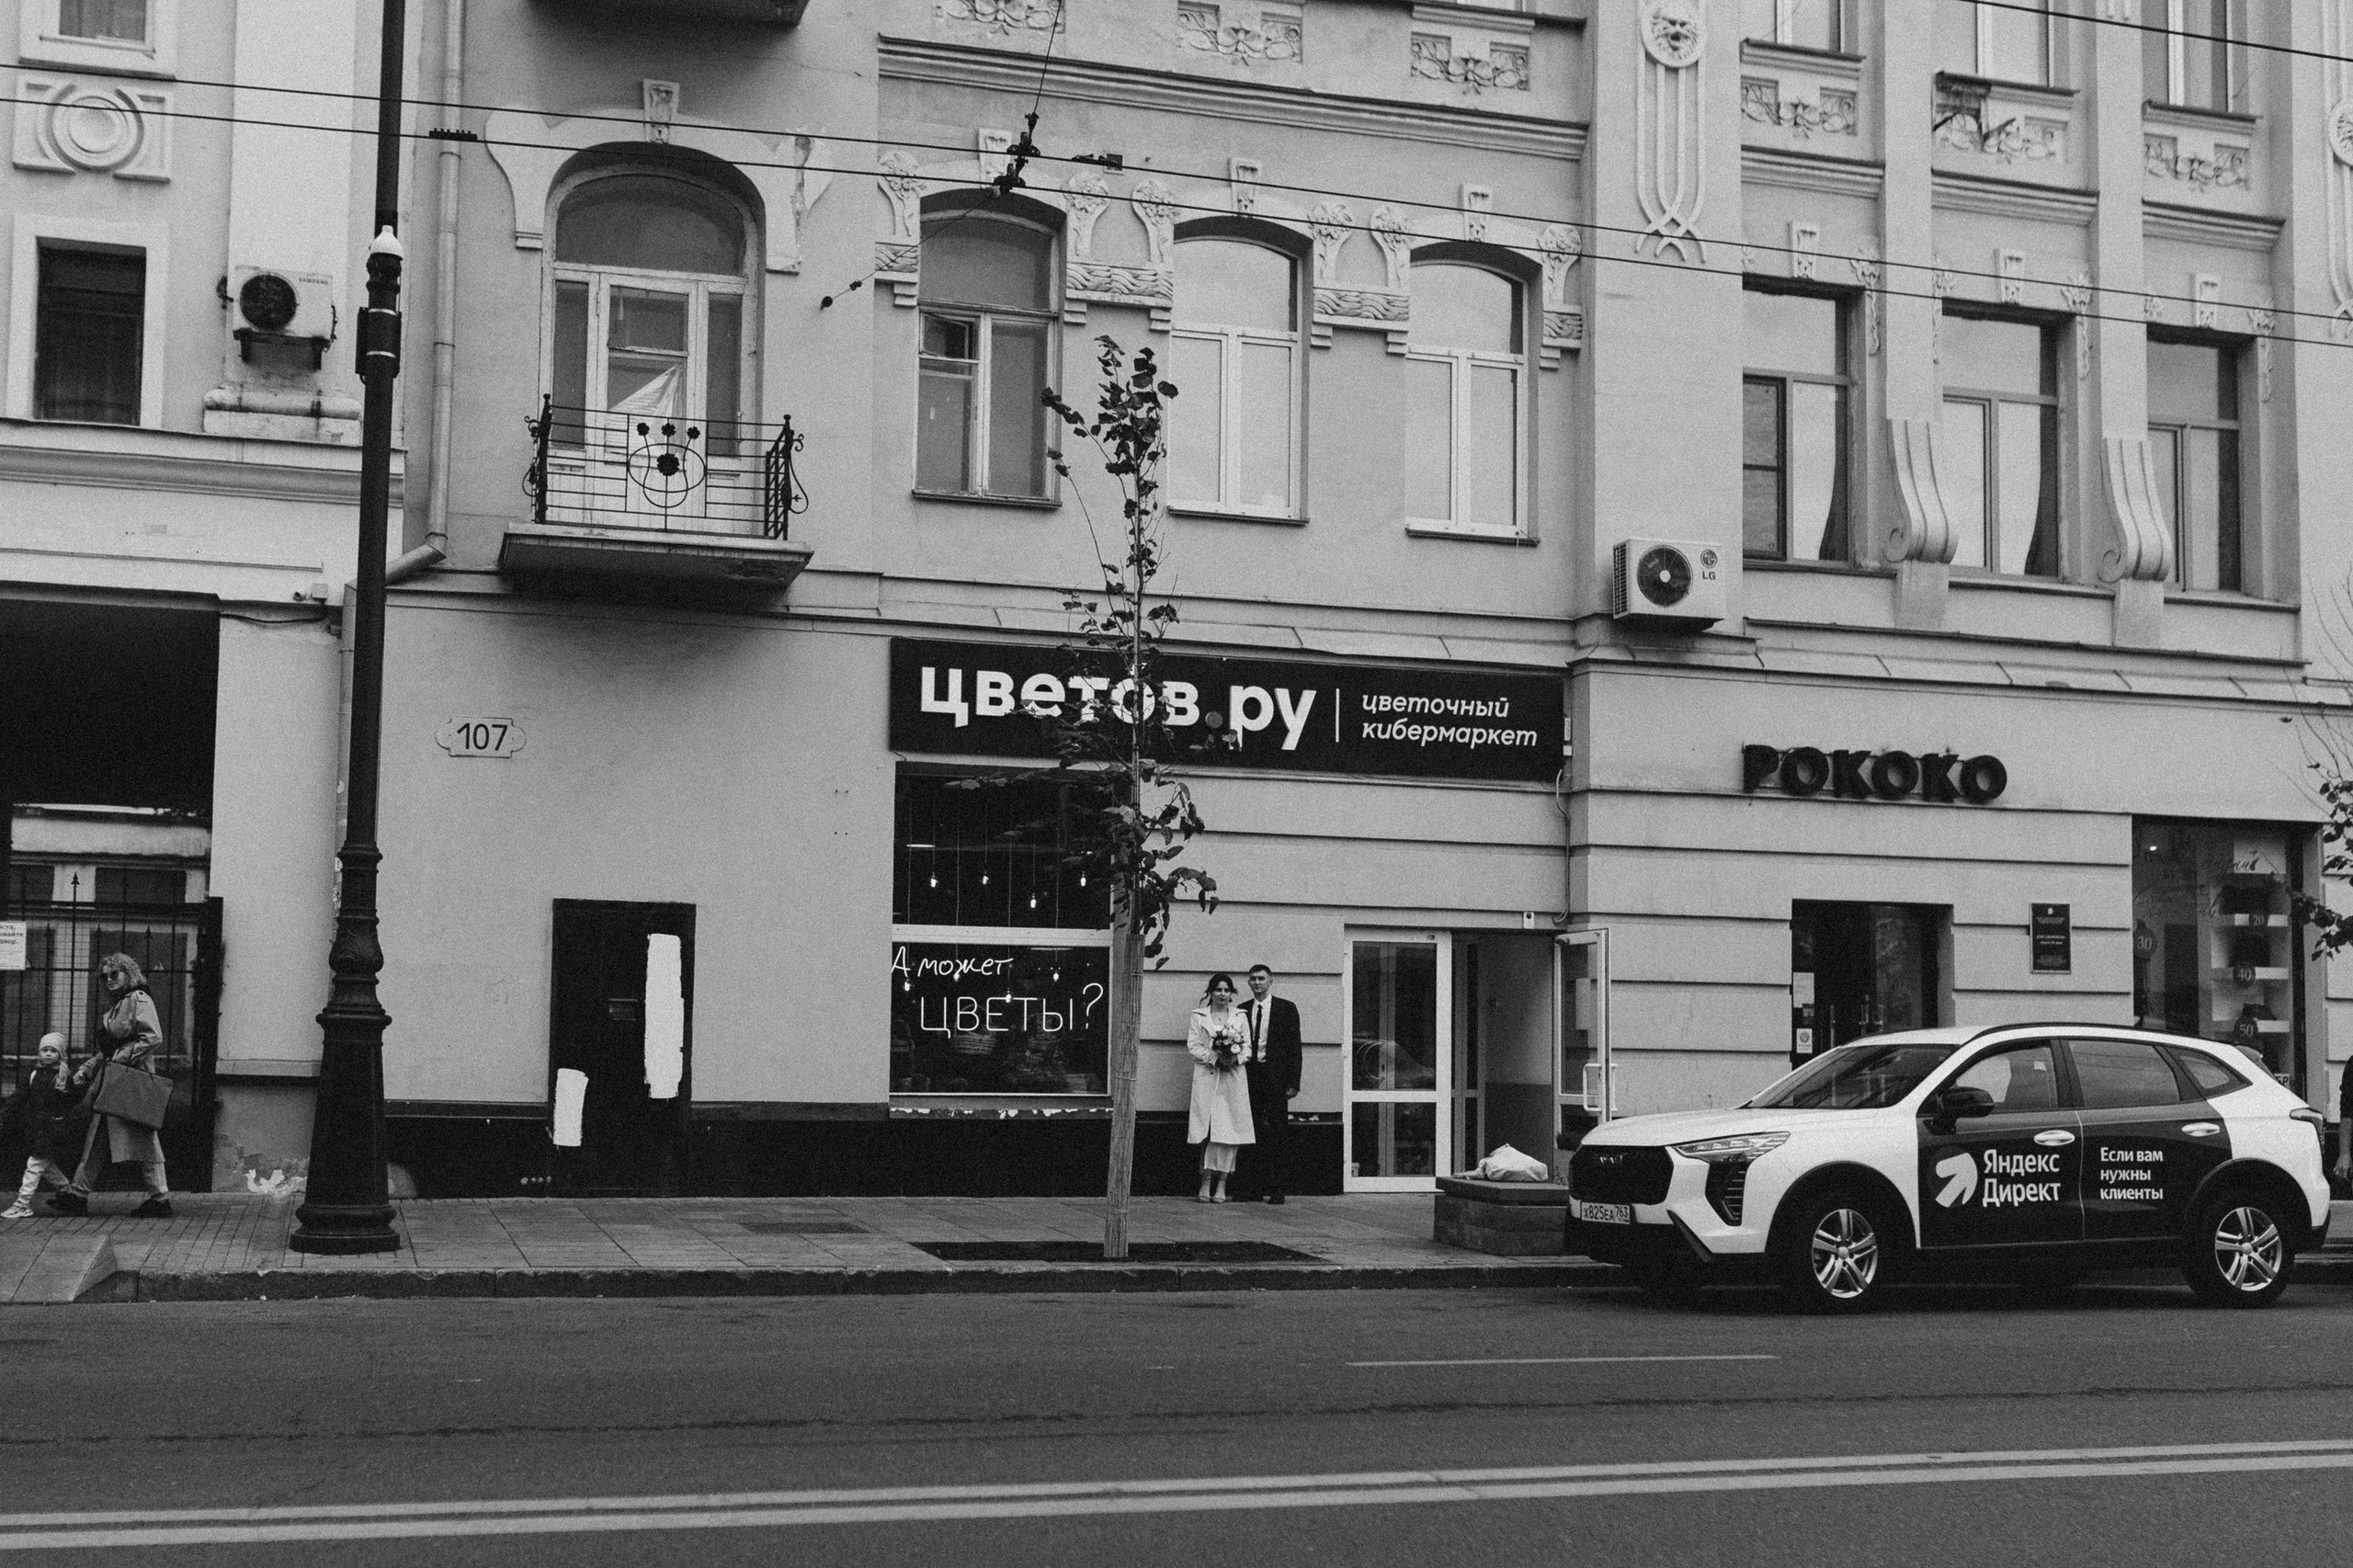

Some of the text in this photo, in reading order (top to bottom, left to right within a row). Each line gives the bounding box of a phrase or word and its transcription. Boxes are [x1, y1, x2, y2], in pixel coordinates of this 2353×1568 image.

[1702, 571, 1716, 580] LG
[1362, 694, 1509, 718] цветочный
[456, 722, 508, 752] 107
[1362, 717, 1538, 749] кибермаркет
[1742, 744, 2007, 804] РОКОКО
[2136, 935, 2153, 951] 30
[892, 946, 1014, 977] А может
[2237, 969, 2252, 982] 40
[920, 983, 1104, 1040] ЦВЕТЫ?
[2240, 1023, 2254, 1037] 50
[1984, 1149, 2061, 1176] Яндекс
[2100, 1147, 2164, 1163] Если вам
[2100, 1169, 2152, 1184] нужны
[1982, 1178, 2062, 1208] Директ
[2099, 1188, 2164, 1200] клиенты
